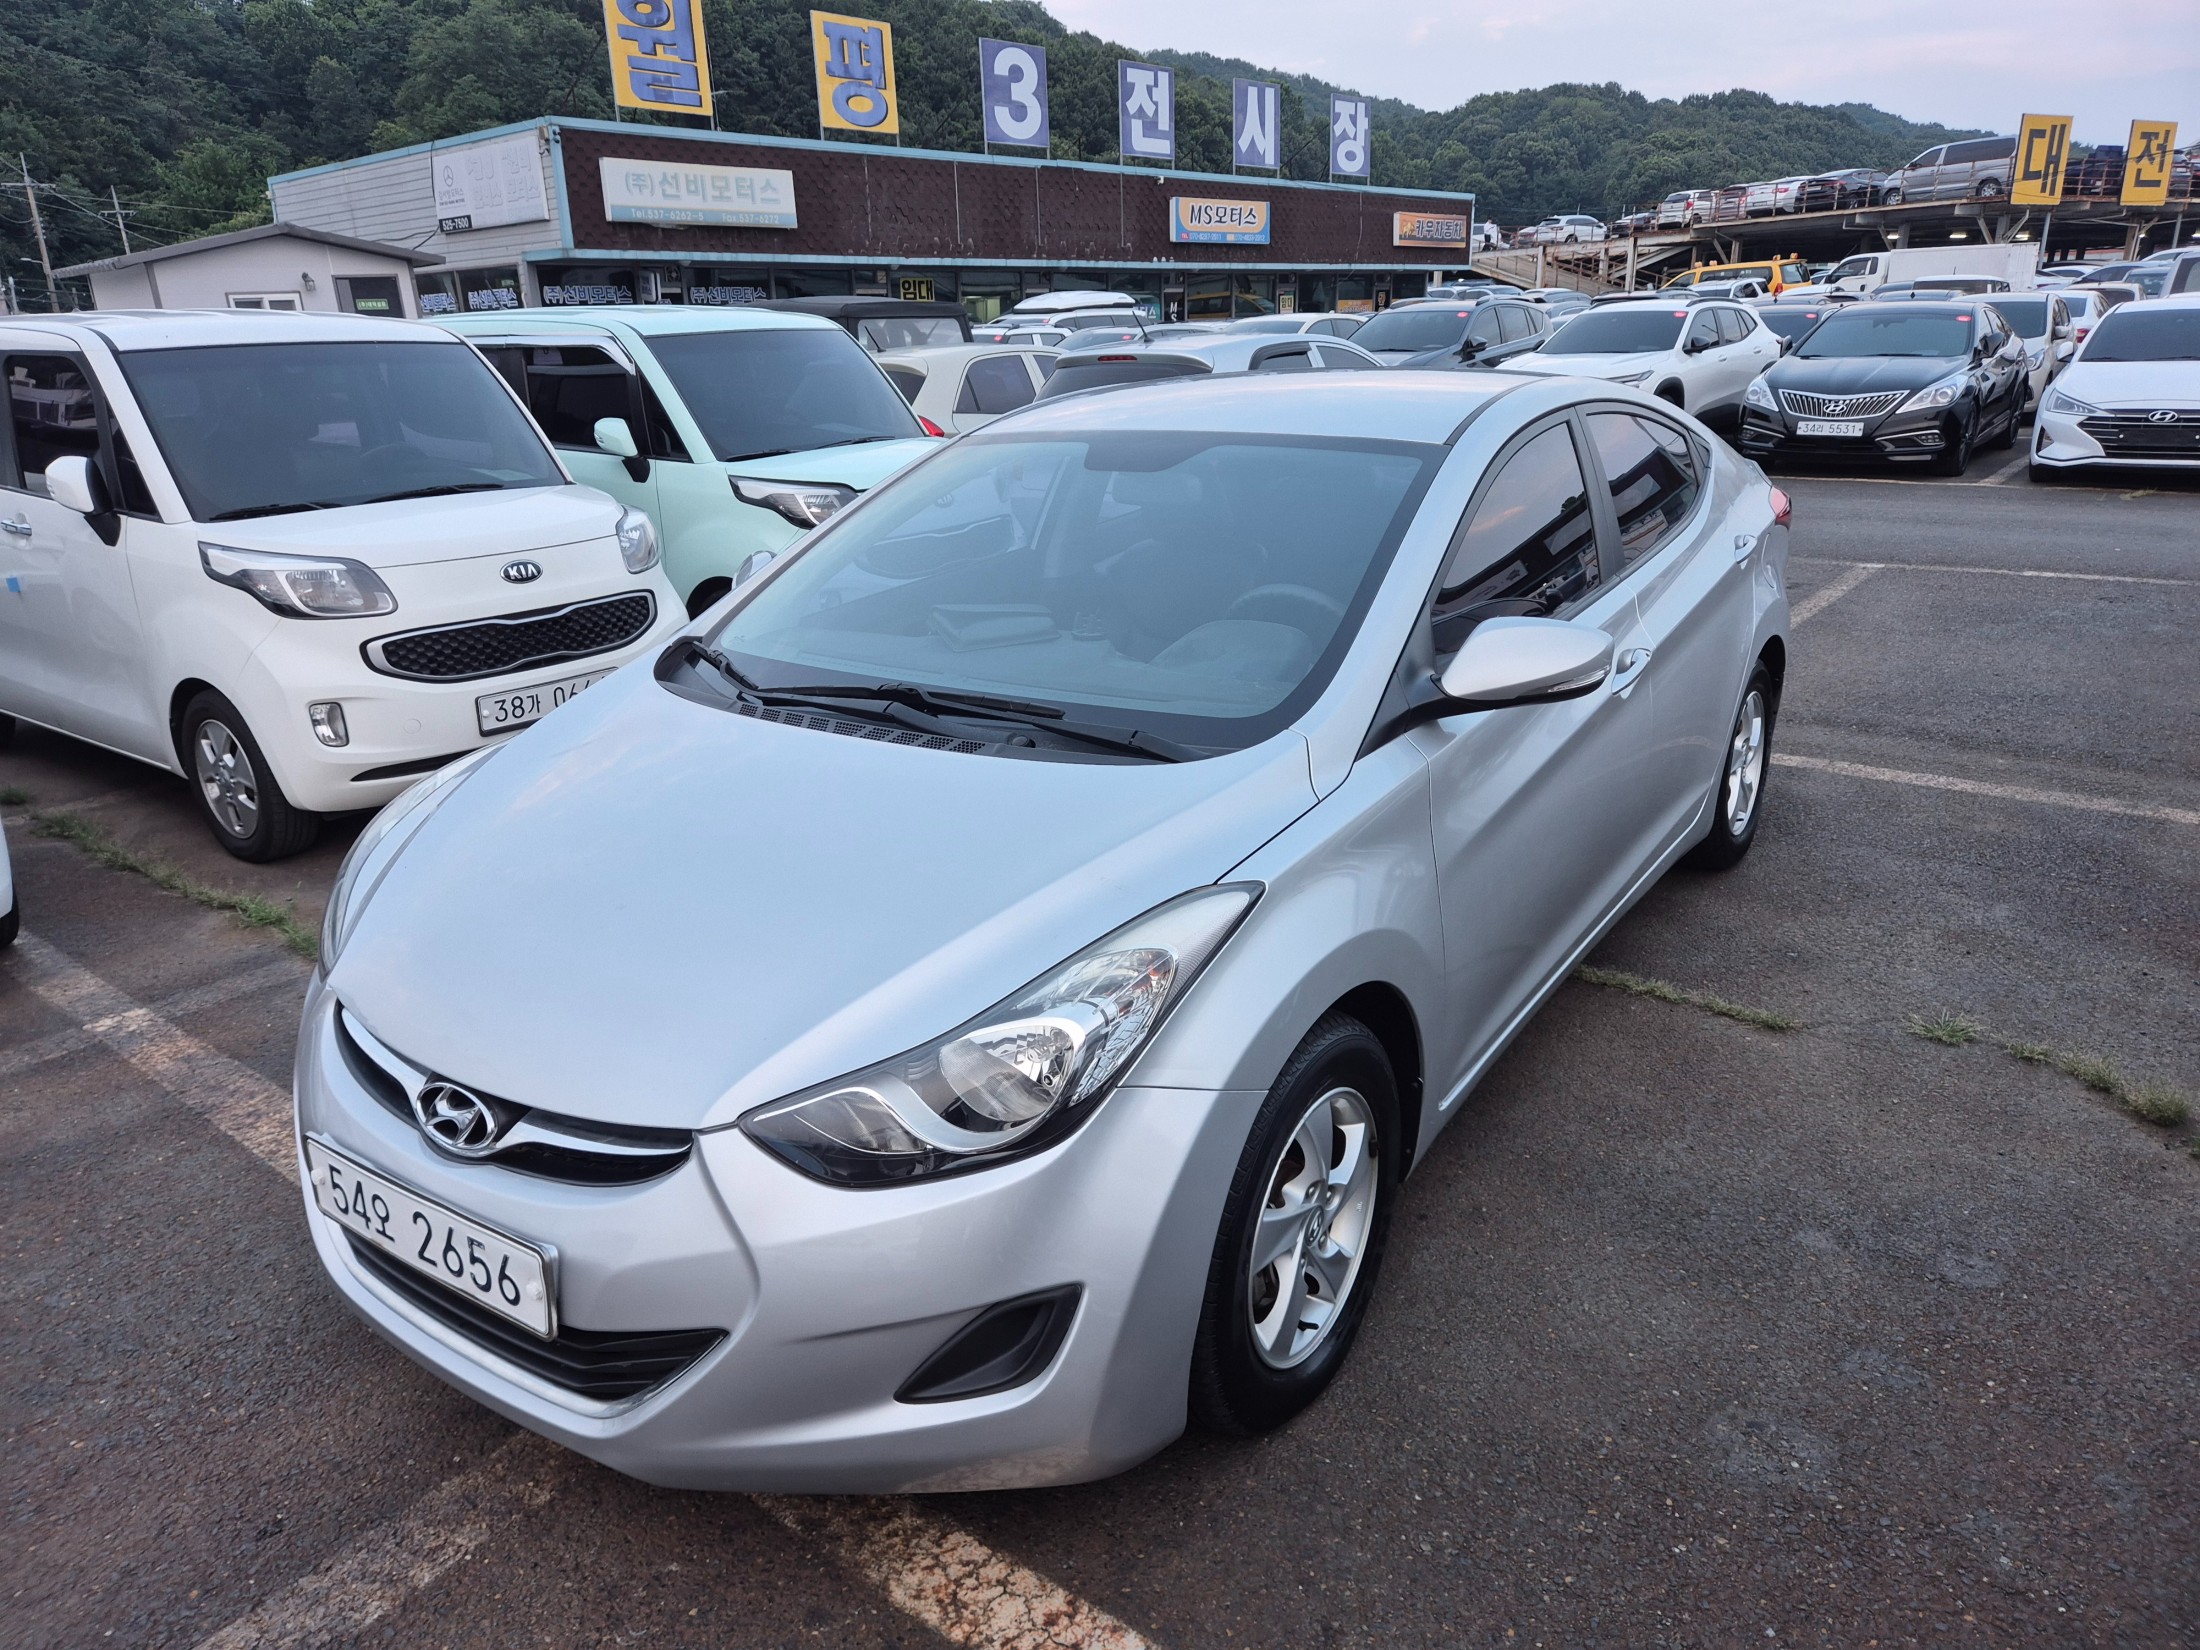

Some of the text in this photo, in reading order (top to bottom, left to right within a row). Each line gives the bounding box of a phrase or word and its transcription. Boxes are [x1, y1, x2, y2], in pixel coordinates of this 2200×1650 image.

[2021, 123, 2171, 197] 대 전
[625, 171, 782, 205] (주)선비모터스
[1190, 204, 1257, 227] MS모터스
[543, 285, 633, 305] (주)선비모터스
[901, 280, 934, 300] 임대
[1828, 423, 1856, 434] 5531
[507, 563, 539, 580] KIA
[494, 693, 541, 723] 38가
[328, 1163, 521, 1307] 54오 2656
